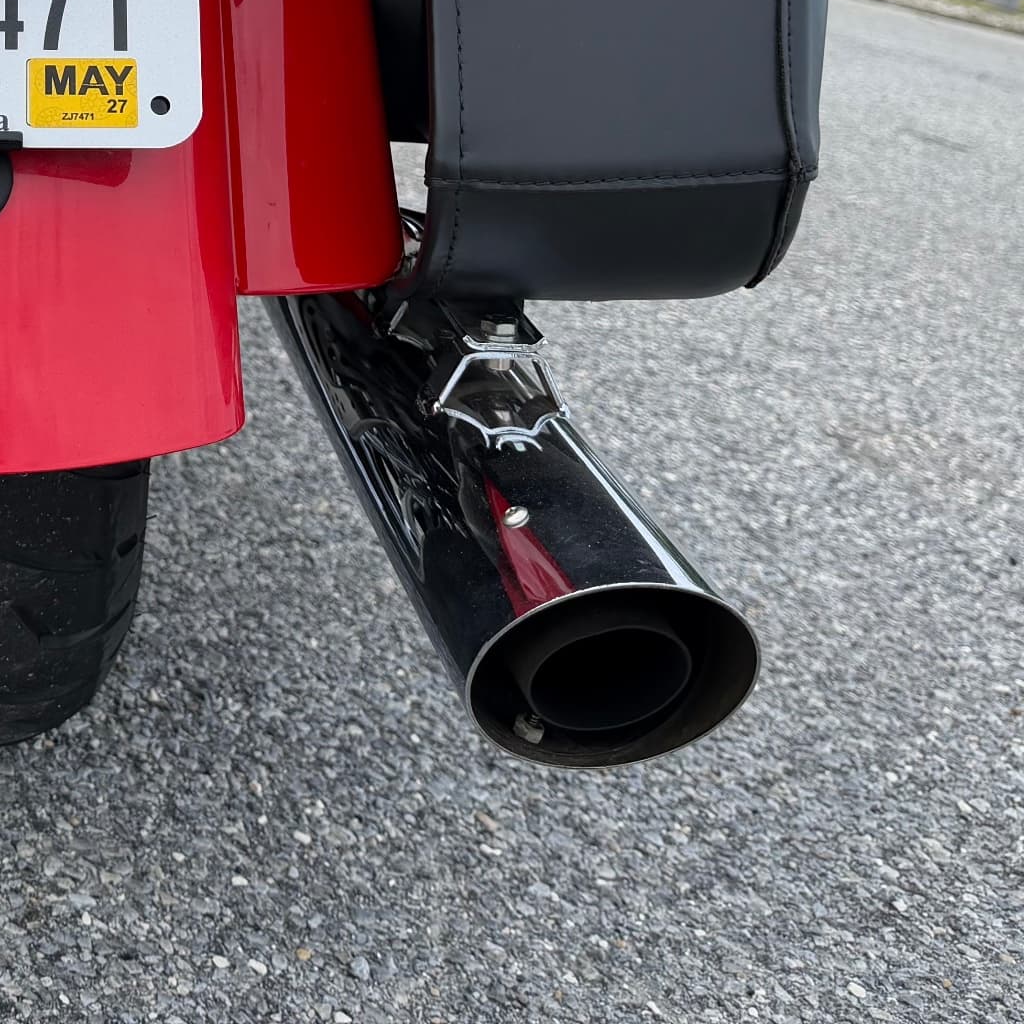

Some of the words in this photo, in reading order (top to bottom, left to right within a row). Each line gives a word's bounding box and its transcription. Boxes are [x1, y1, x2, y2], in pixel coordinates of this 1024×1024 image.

[44, 64, 133, 96] MAY
[107, 99, 128, 114] 27
[61, 112, 95, 121] ZJ7471
